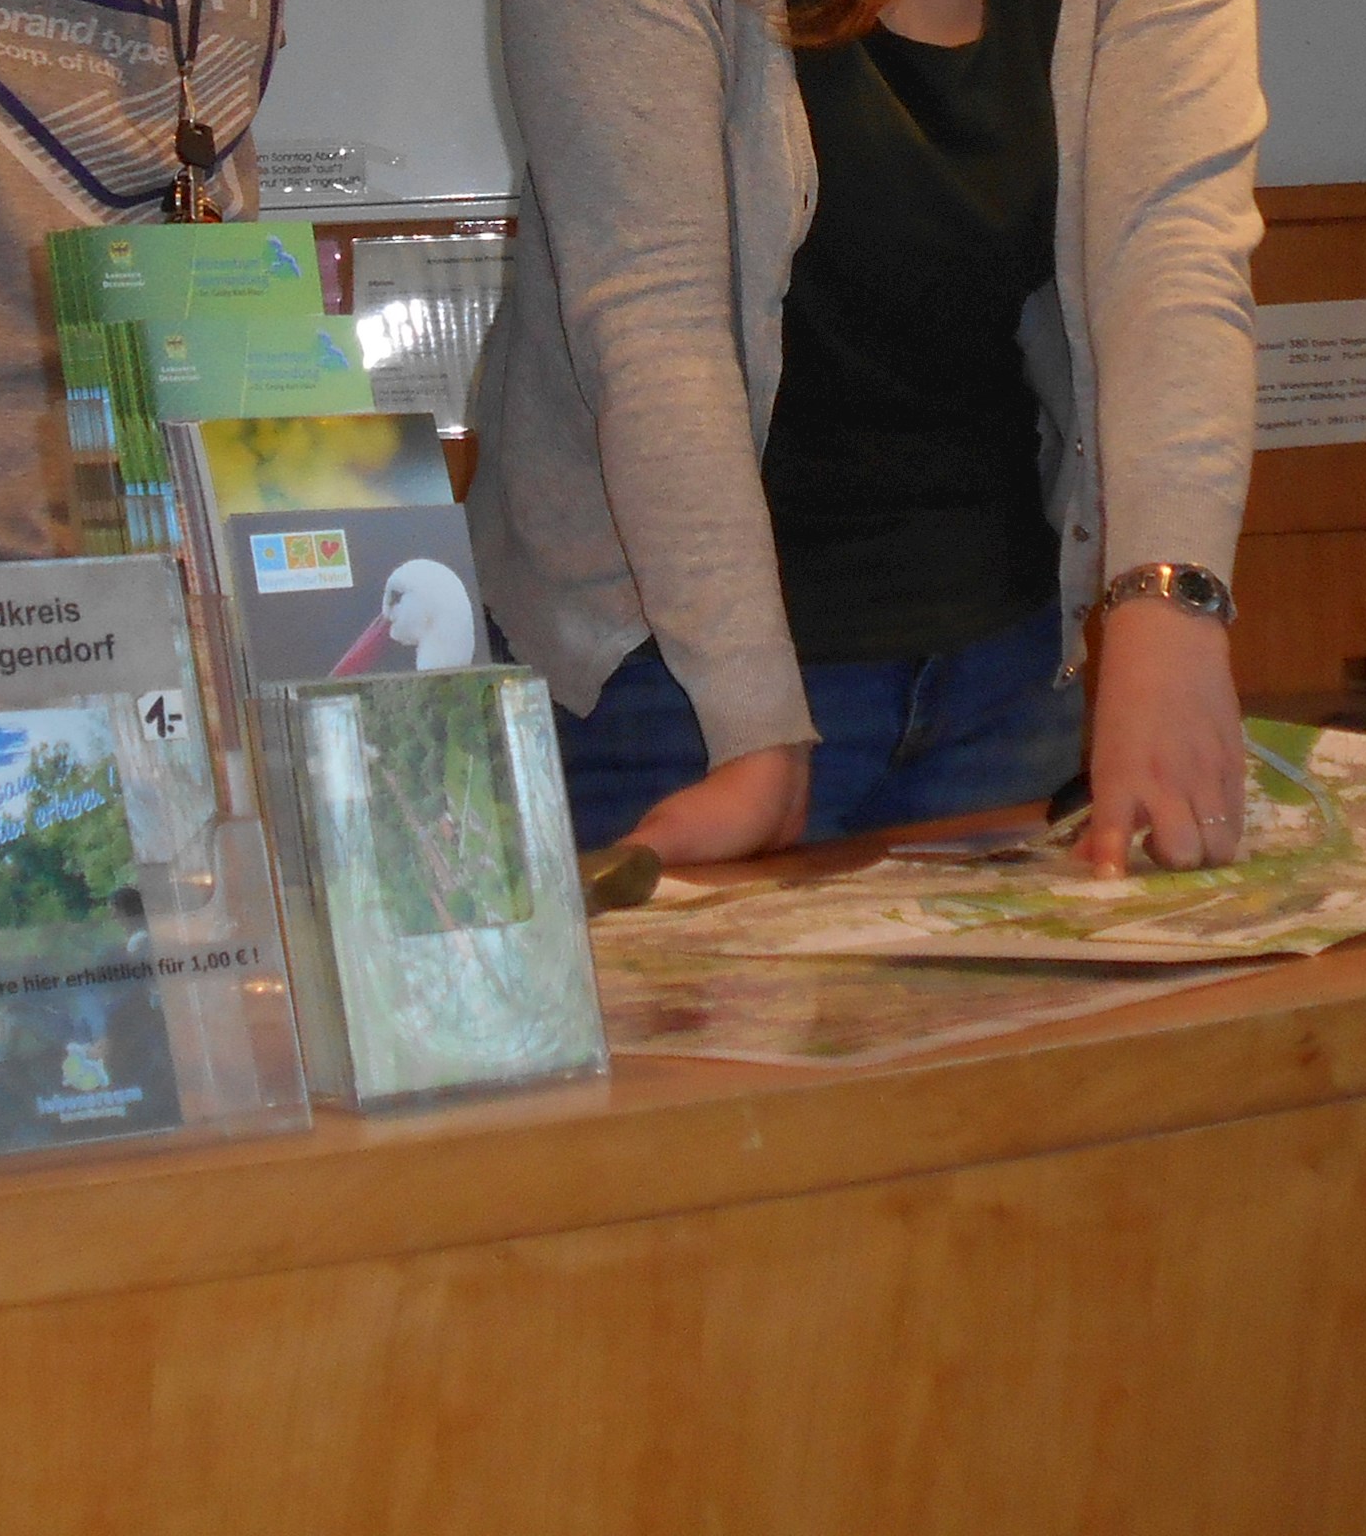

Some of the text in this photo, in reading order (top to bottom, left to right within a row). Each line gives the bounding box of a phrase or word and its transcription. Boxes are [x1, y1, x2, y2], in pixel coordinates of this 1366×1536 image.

[59, 53, 84, 72] of
[102, 28, 170, 65] type
[271, 152, 312, 163] Sonntag
[35, 787, 107, 830] erleben
[23, 973, 61, 994] hier
[65, 961, 154, 988] erhältlich
[156, 957, 187, 976] für
[190, 950, 231, 974] 1,00
[235, 950, 249, 966] €
